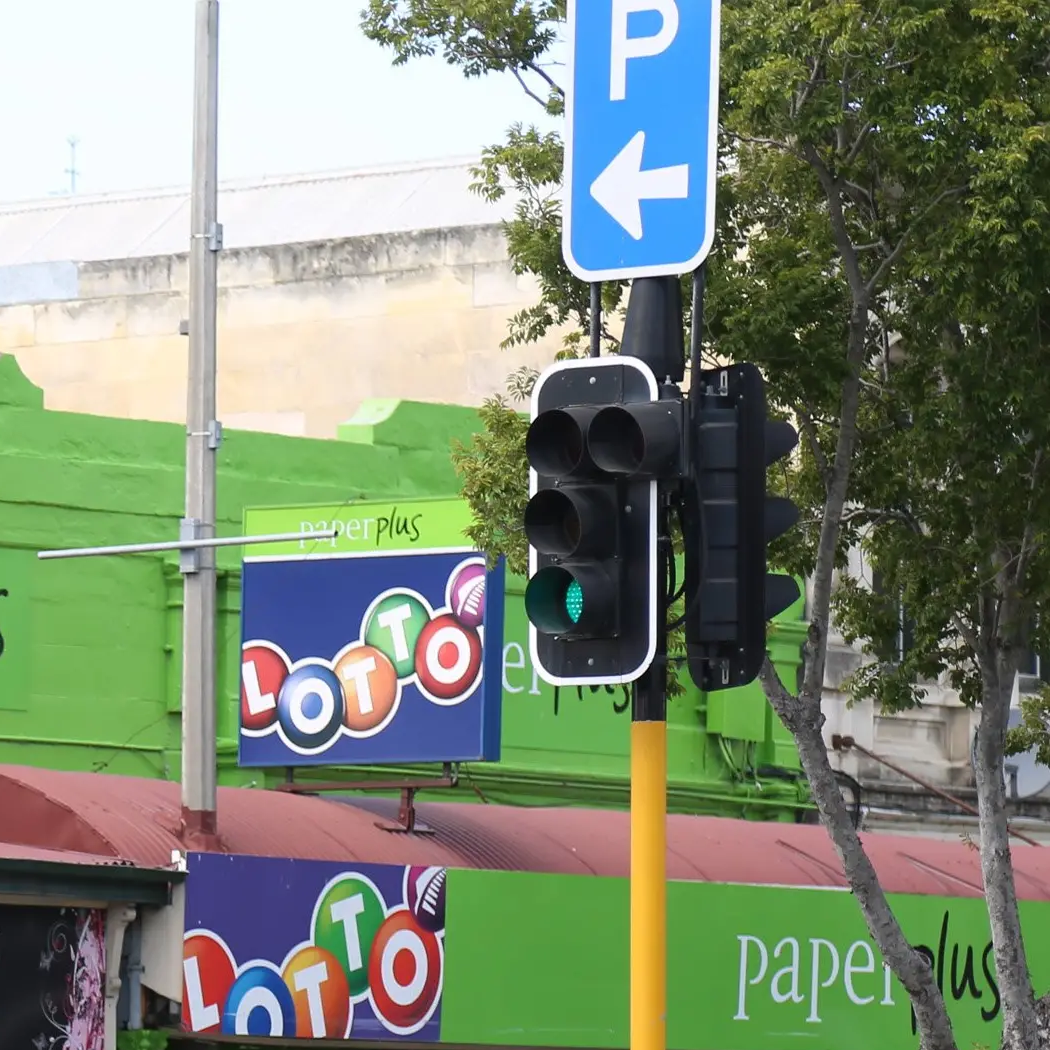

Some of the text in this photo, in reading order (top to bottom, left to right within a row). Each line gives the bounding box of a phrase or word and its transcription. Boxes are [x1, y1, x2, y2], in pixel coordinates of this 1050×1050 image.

[609, 0, 680, 101] P
[241, 602, 472, 735] LOTTO
[183, 892, 429, 1039] LOTTO
